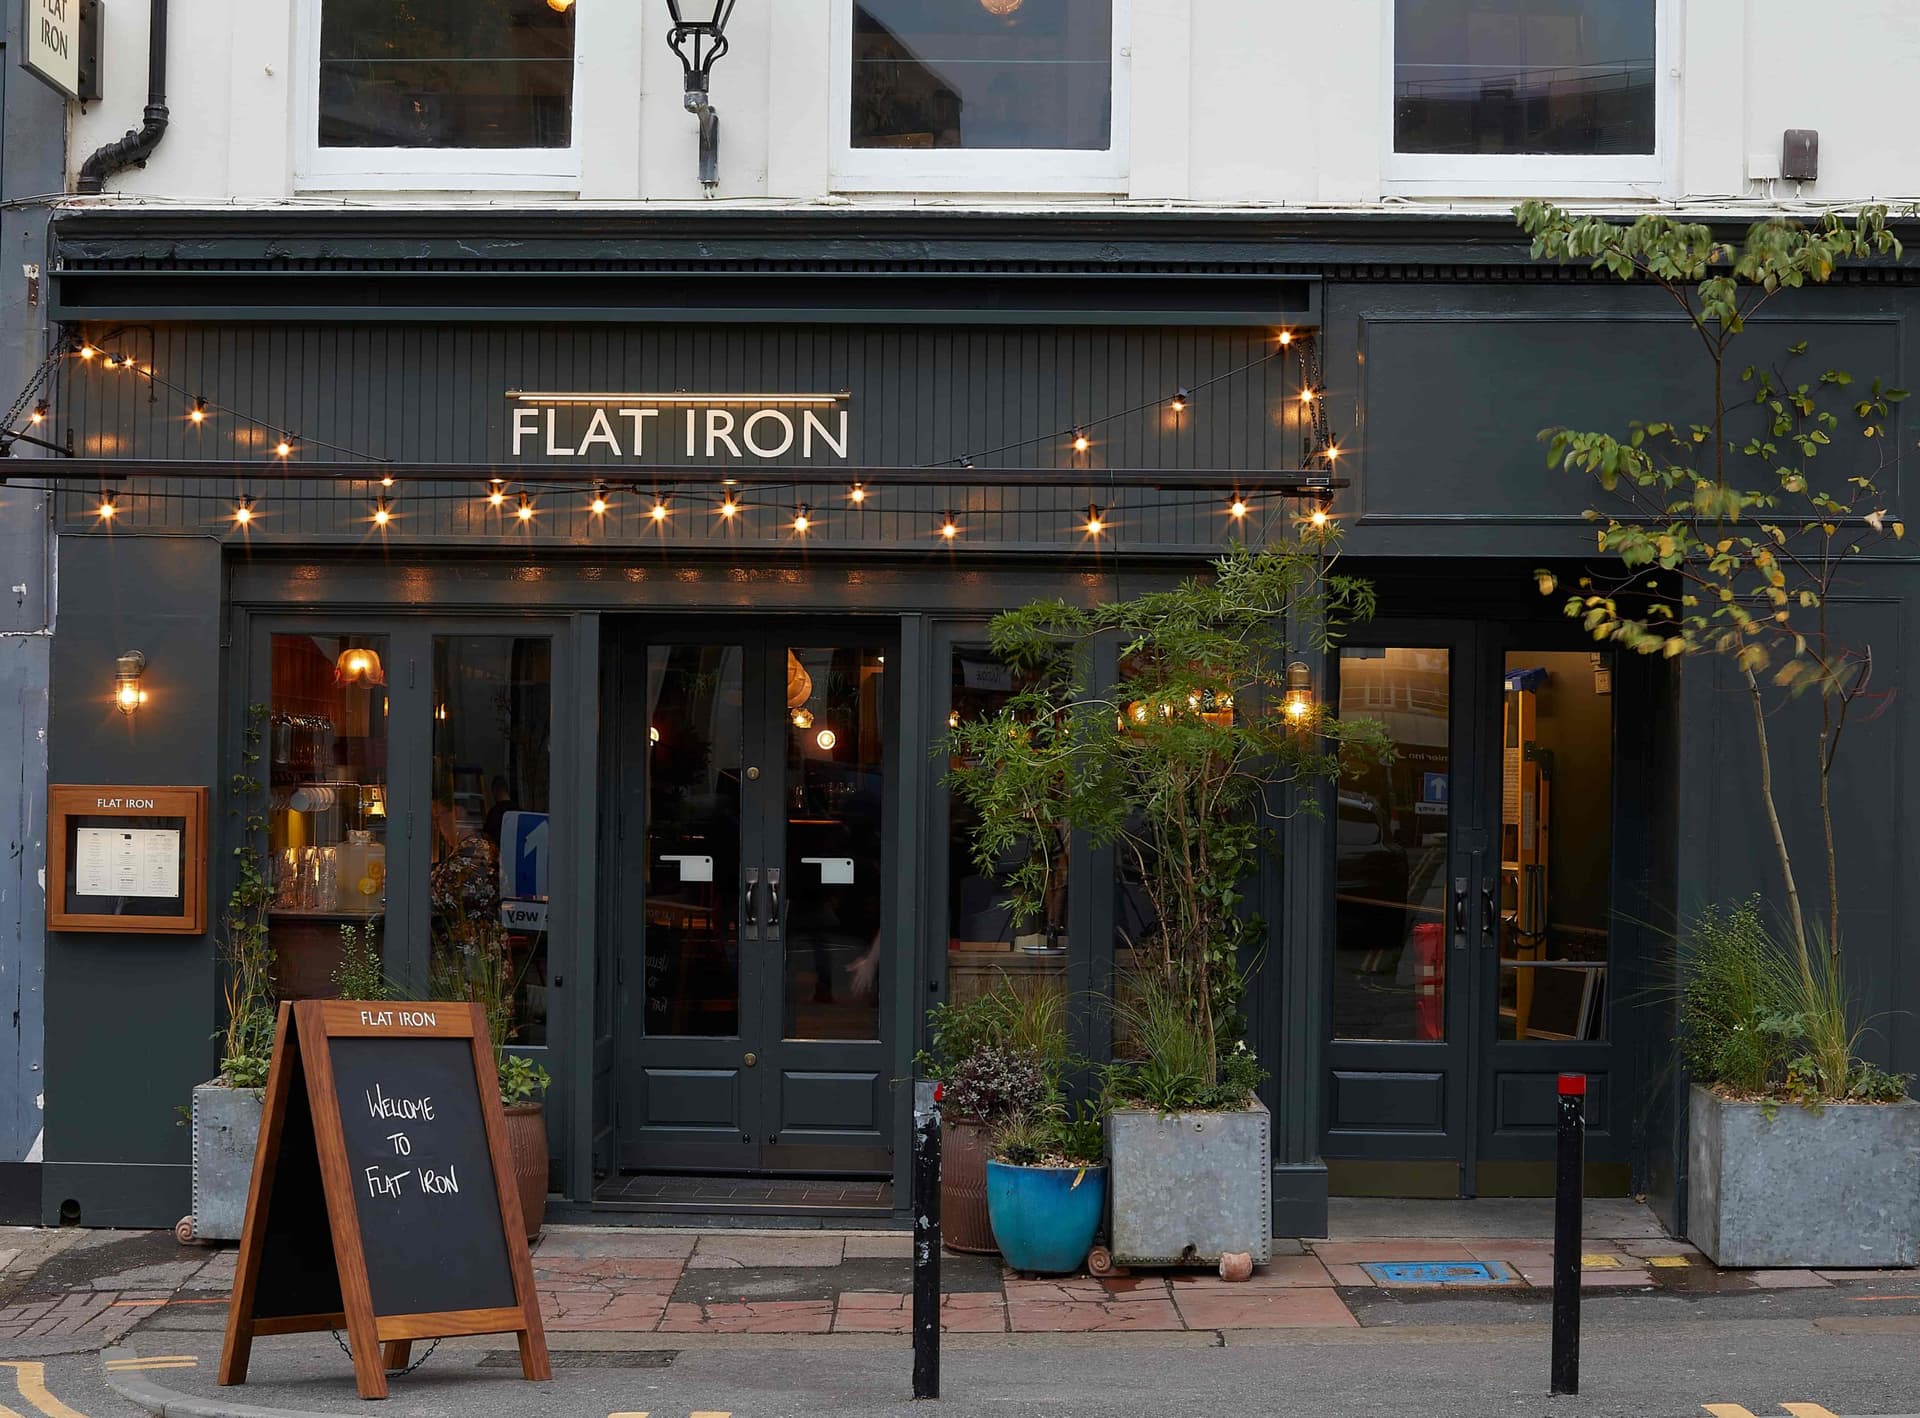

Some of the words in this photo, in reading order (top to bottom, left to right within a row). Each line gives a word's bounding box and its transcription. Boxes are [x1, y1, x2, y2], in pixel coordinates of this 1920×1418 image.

[41, 17, 68, 60] IRON
[512, 408, 659, 456] FLAT
[686, 409, 848, 459] IRON
[97, 798, 122, 808] FLAT
[126, 799, 154, 809] IRON
[361, 1011, 393, 1026] FLAT
[399, 1012, 436, 1027] IRON
[366, 1083, 435, 1121] WELCOME
[387, 1132, 411, 1155] TO
[365, 1165, 411, 1198] FLAT
[418, 1164, 459, 1194] IRON
